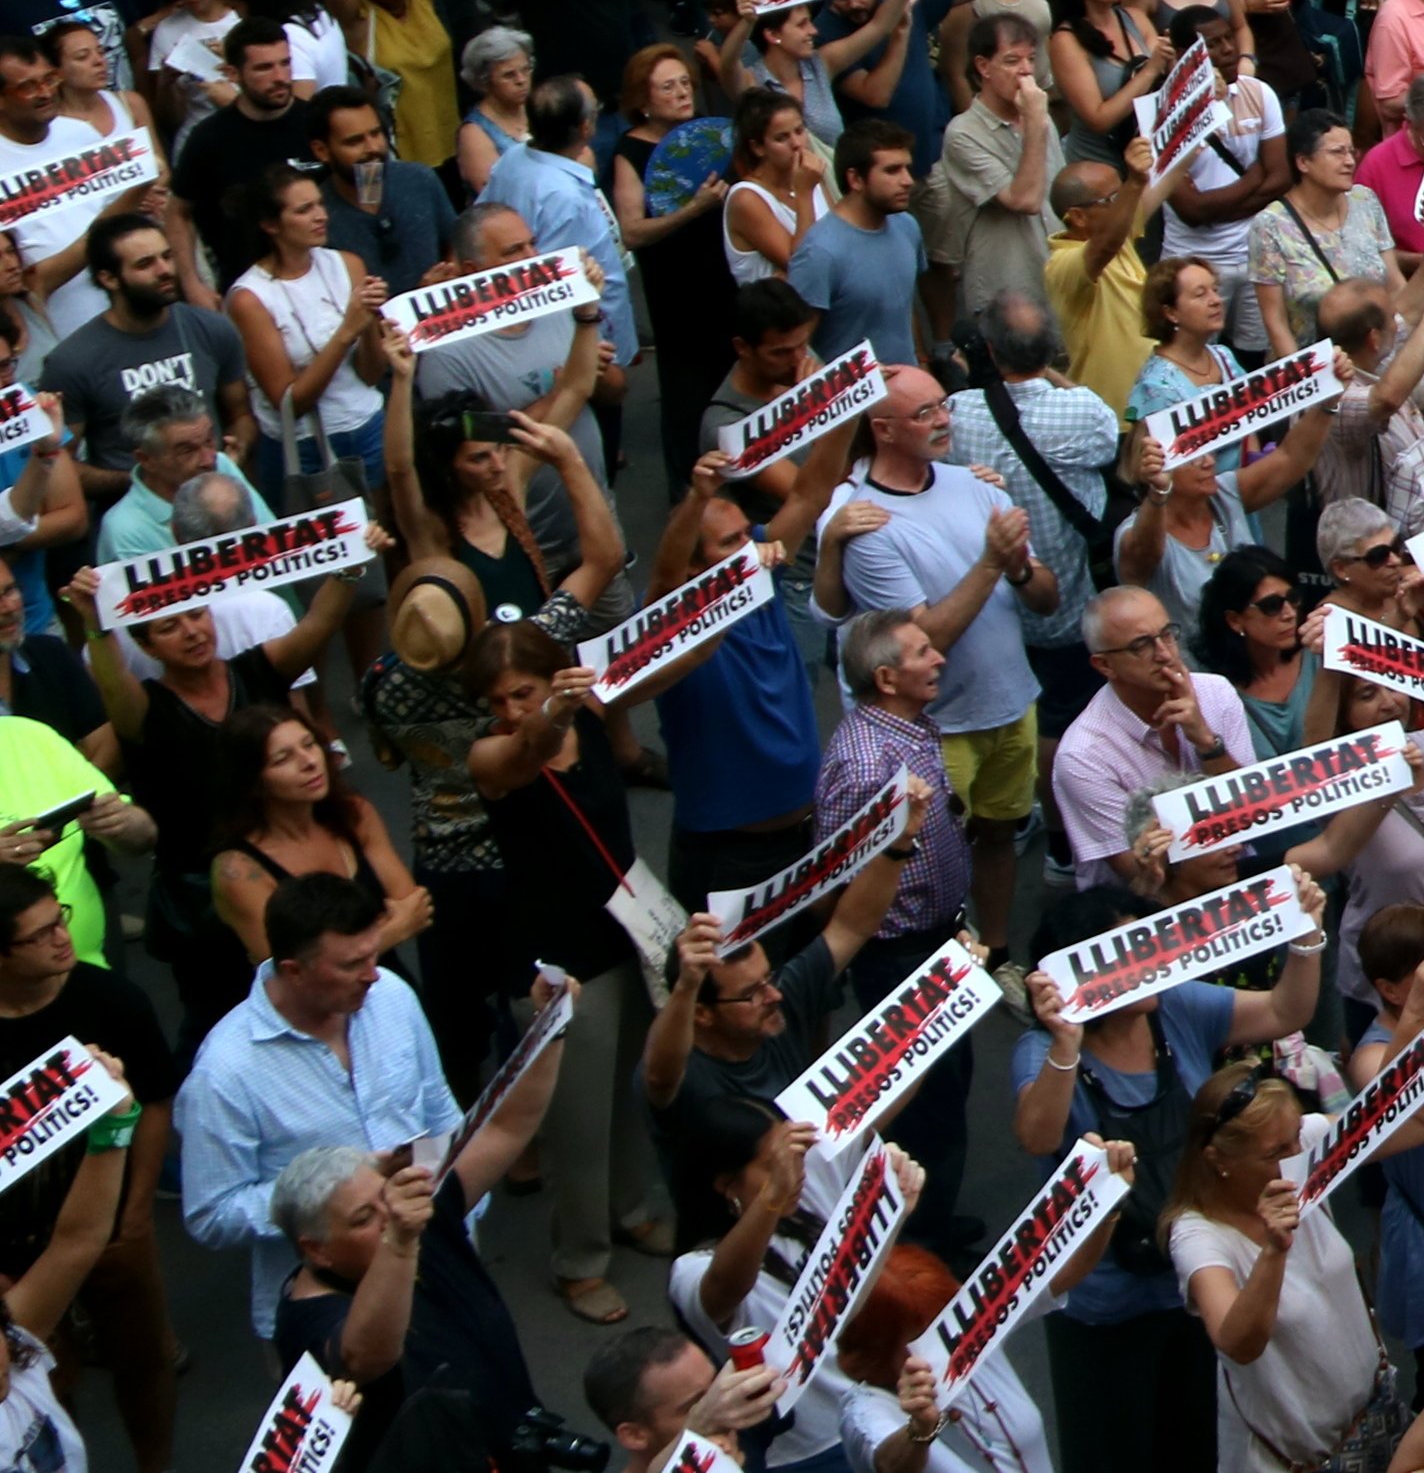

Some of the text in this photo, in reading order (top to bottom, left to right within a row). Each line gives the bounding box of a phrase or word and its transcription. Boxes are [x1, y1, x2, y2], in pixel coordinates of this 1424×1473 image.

[407, 259, 566, 323] LLIBERTAT
[121, 352, 193, 392] DON'T
[1170, 353, 1316, 436] LLIBERTAT
[127, 512, 338, 589] LLIBERTAT
[607, 558, 751, 662] LLIBERTAT
[1189, 734, 1382, 820] LLIBERTAT
[741, 783, 898, 917] LLIBERTAT
[1069, 882, 1273, 980] LLIBERTAT
[805, 961, 960, 1111] LLIBERTAT
[797, 1183, 900, 1385] LLIBERTAT
[935, 1158, 1087, 1346] LLIBERTAT
